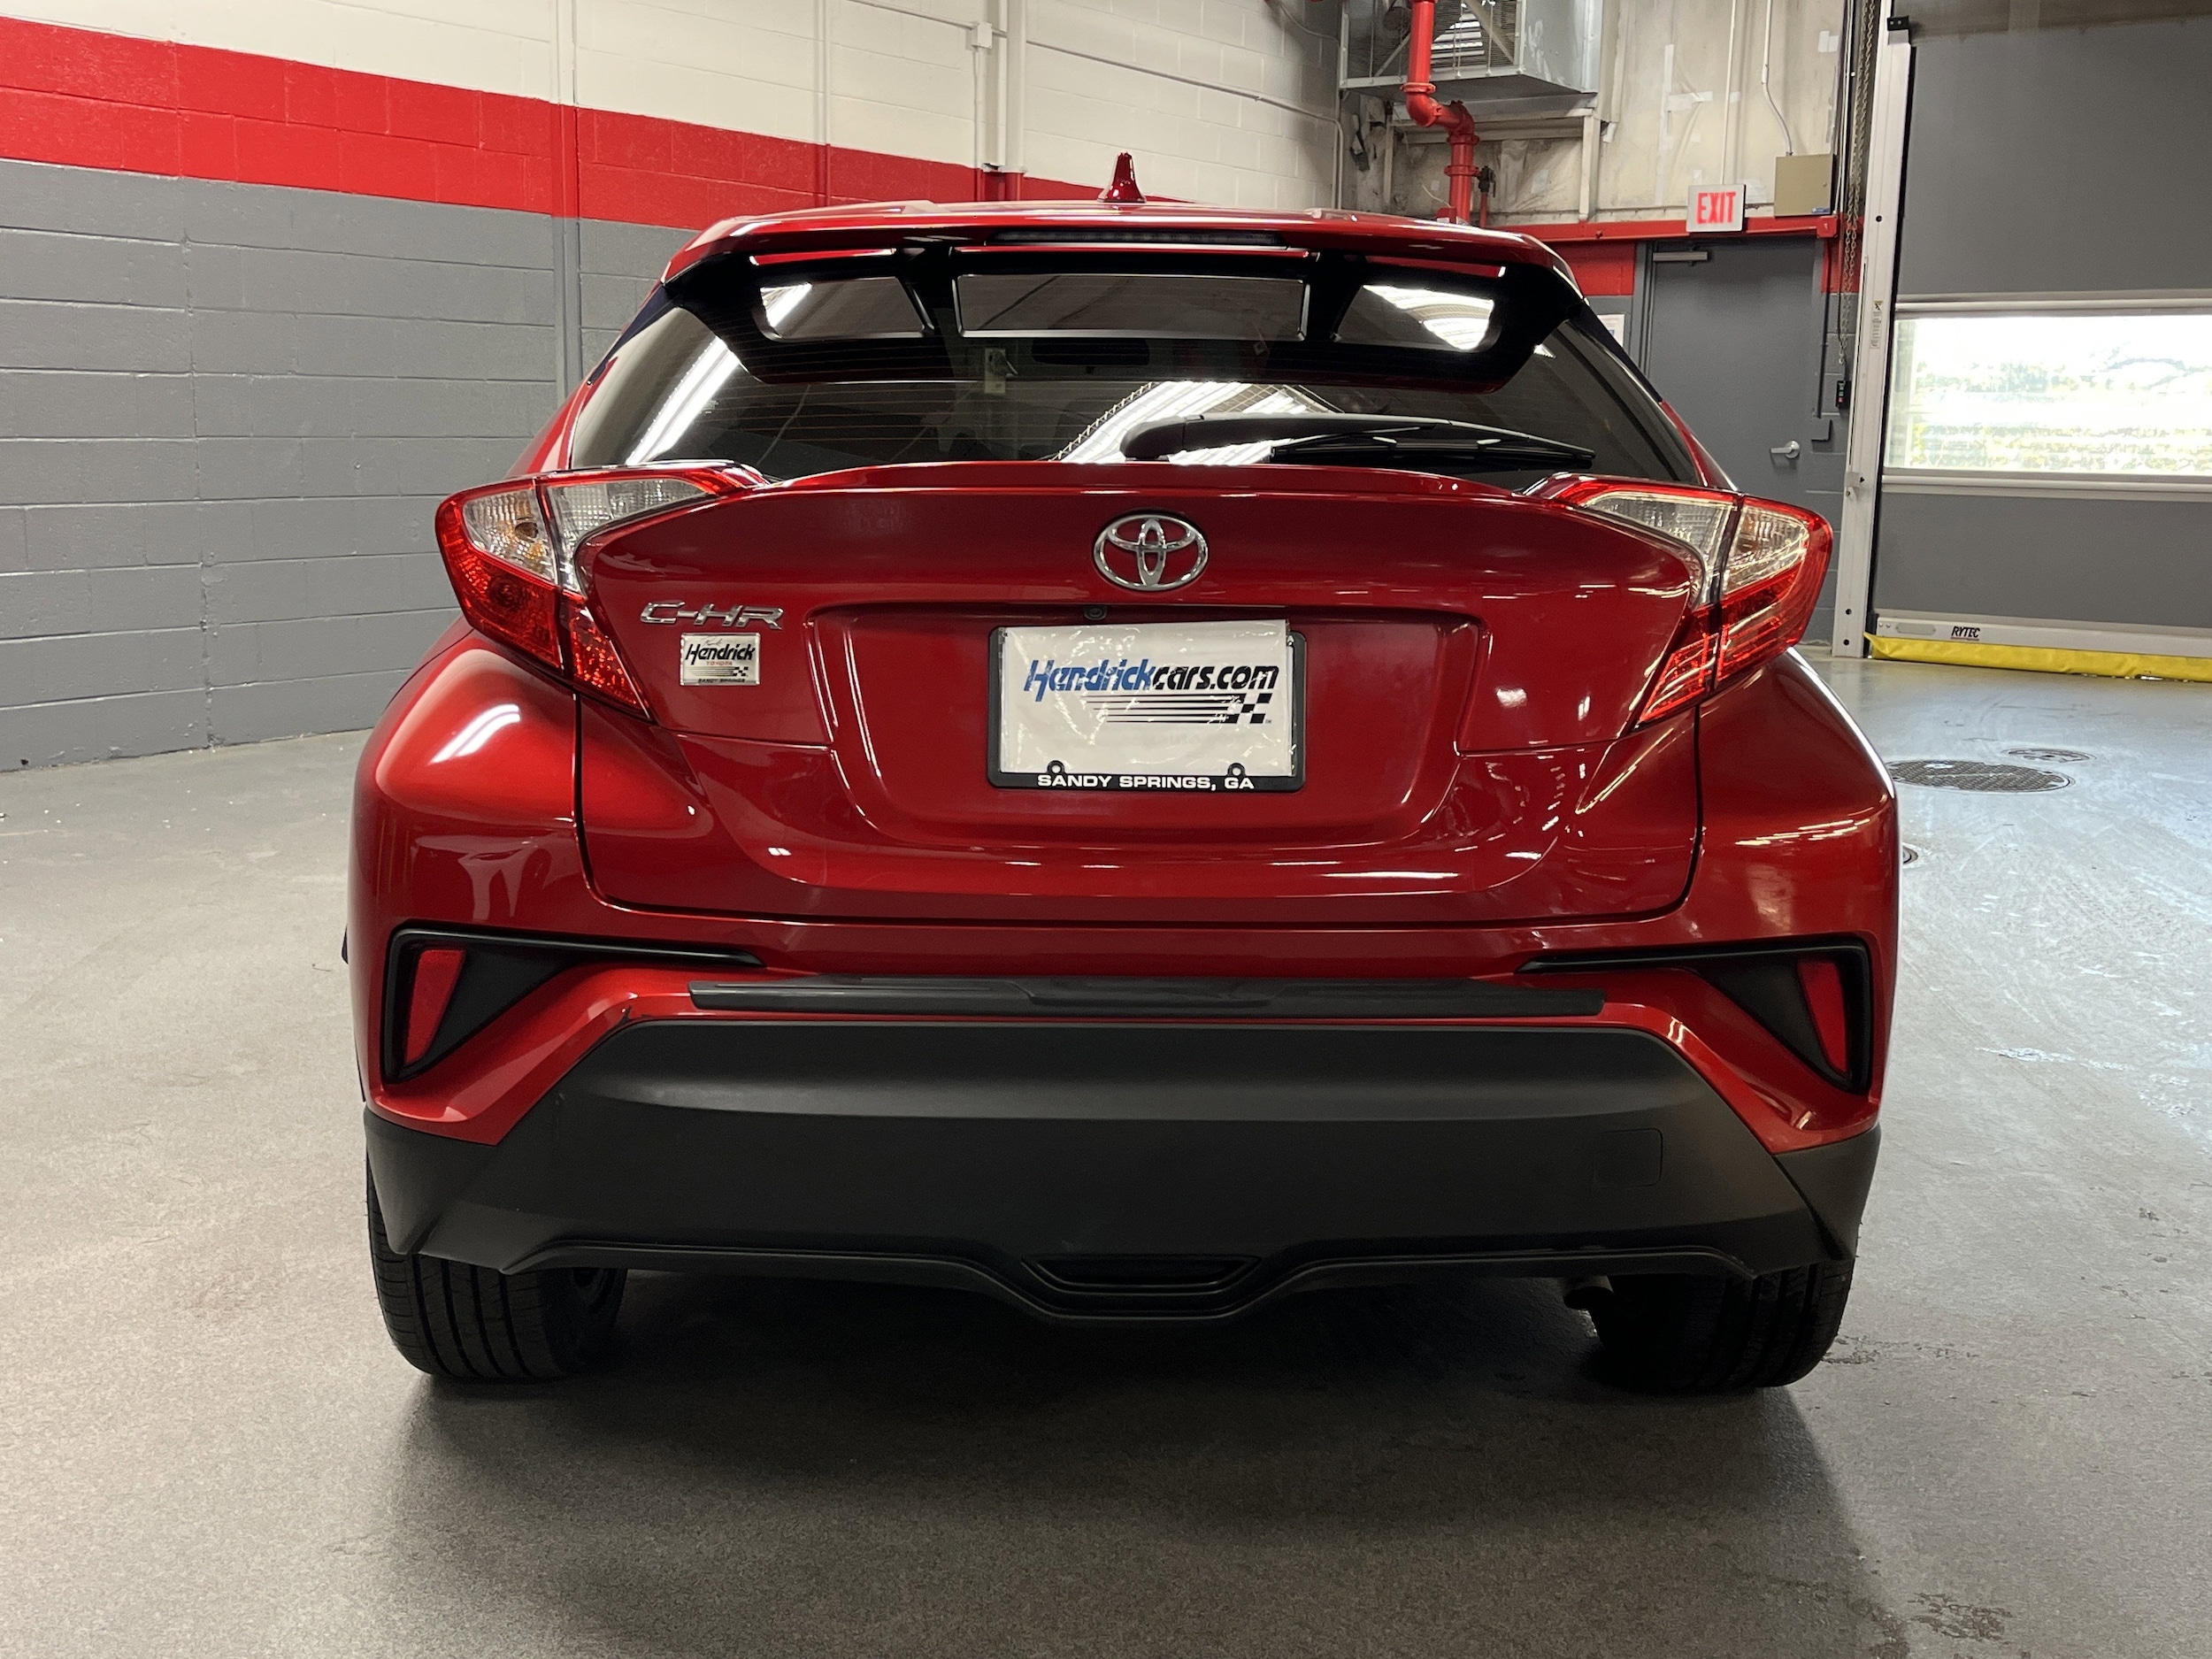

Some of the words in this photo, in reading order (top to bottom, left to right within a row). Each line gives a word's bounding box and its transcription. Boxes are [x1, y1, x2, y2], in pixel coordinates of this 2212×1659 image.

[1697, 192, 1736, 224] EXIT
[641, 602, 783, 629] C-HR
[1951, 626, 1980, 638] RYTEC
[685, 643, 755, 665] Hendrick
[1024, 659, 1279, 702] Hendrickcars.com
[1038, 774, 1111, 787] SANDY
[1119, 776, 1217, 791] SPRINGS,
[1225, 778, 1255, 789] GA
